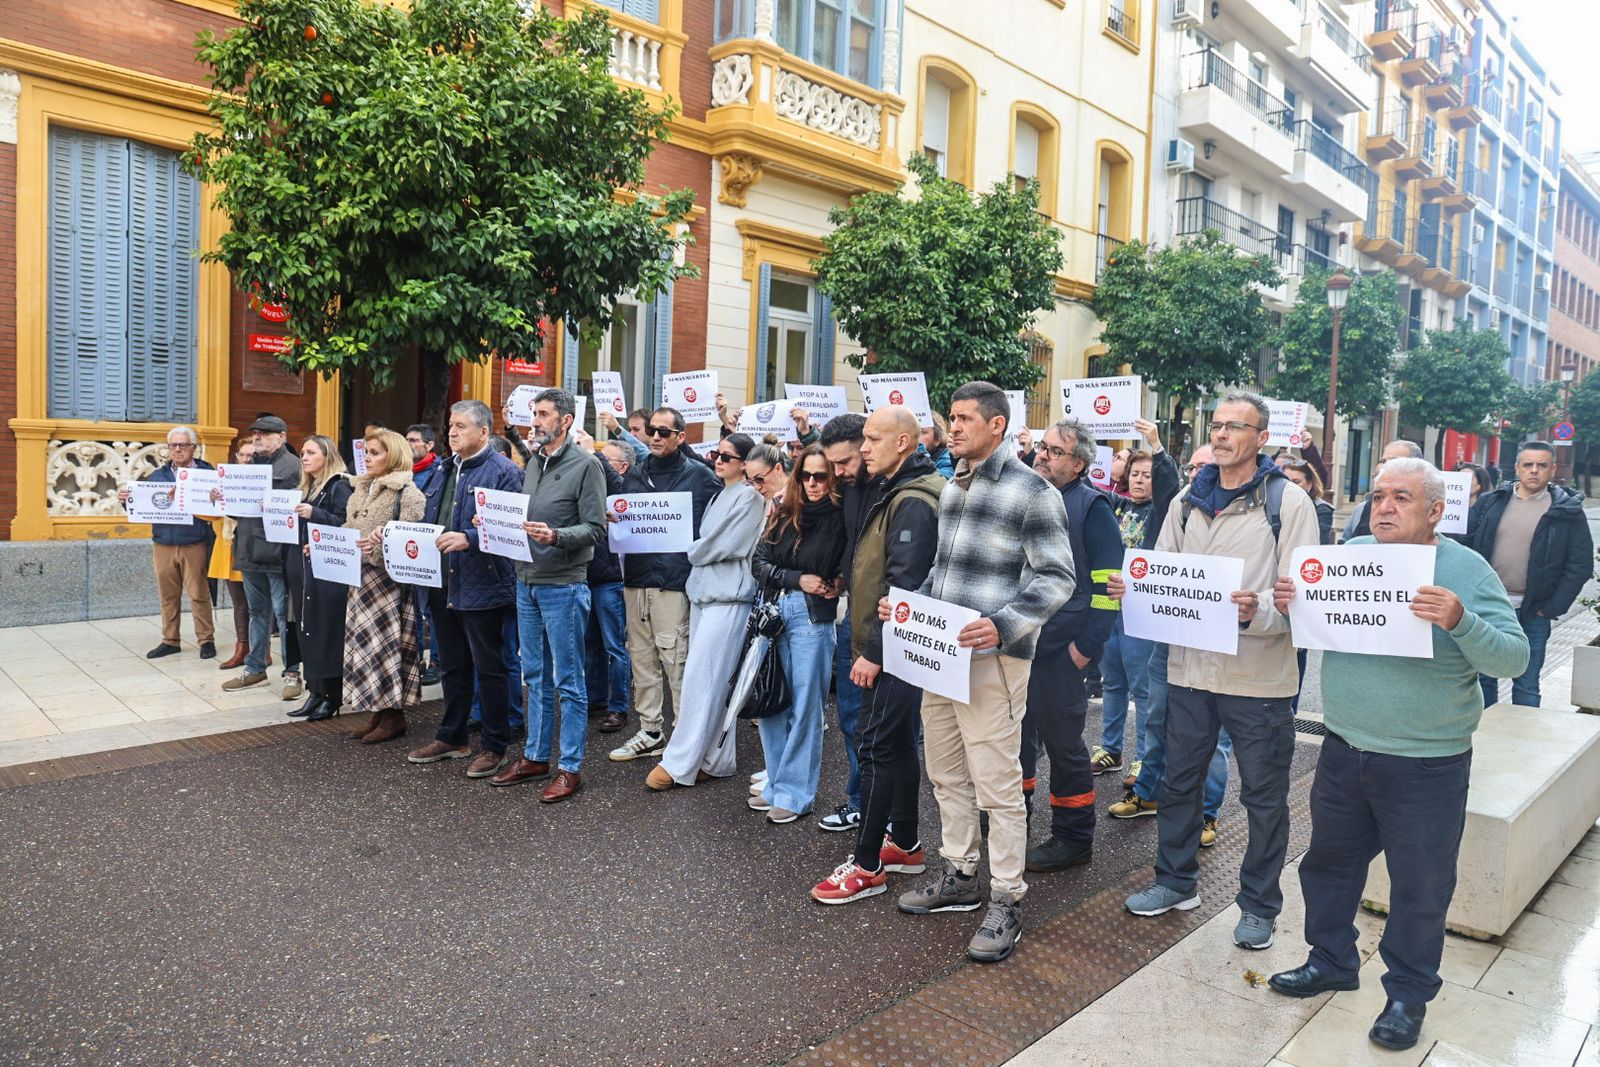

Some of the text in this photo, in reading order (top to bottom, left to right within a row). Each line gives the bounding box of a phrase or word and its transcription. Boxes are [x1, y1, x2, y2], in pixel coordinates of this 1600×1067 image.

[619, 513, 682, 521] SINIESTRALIDAD
[315, 544, 355, 556] SINIESTRALIDAD
[324, 557, 347, 566] LABORAL
[1149, 564, 1205, 579] STOP A LA
[1327, 562, 1383, 577] NO MÁS
[1133, 582, 1222, 602] SINIESTRALIDAD
[1306, 589, 1411, 603] MUERTES EN EL
[1152, 604, 1201, 620] LABORAL
[1325, 612, 1386, 626] TRABAJO
[912, 611, 946, 630] NO MÁS
[894, 627, 957, 656] MUERTES EN EL
[904, 650, 940, 671] TRABAJO
